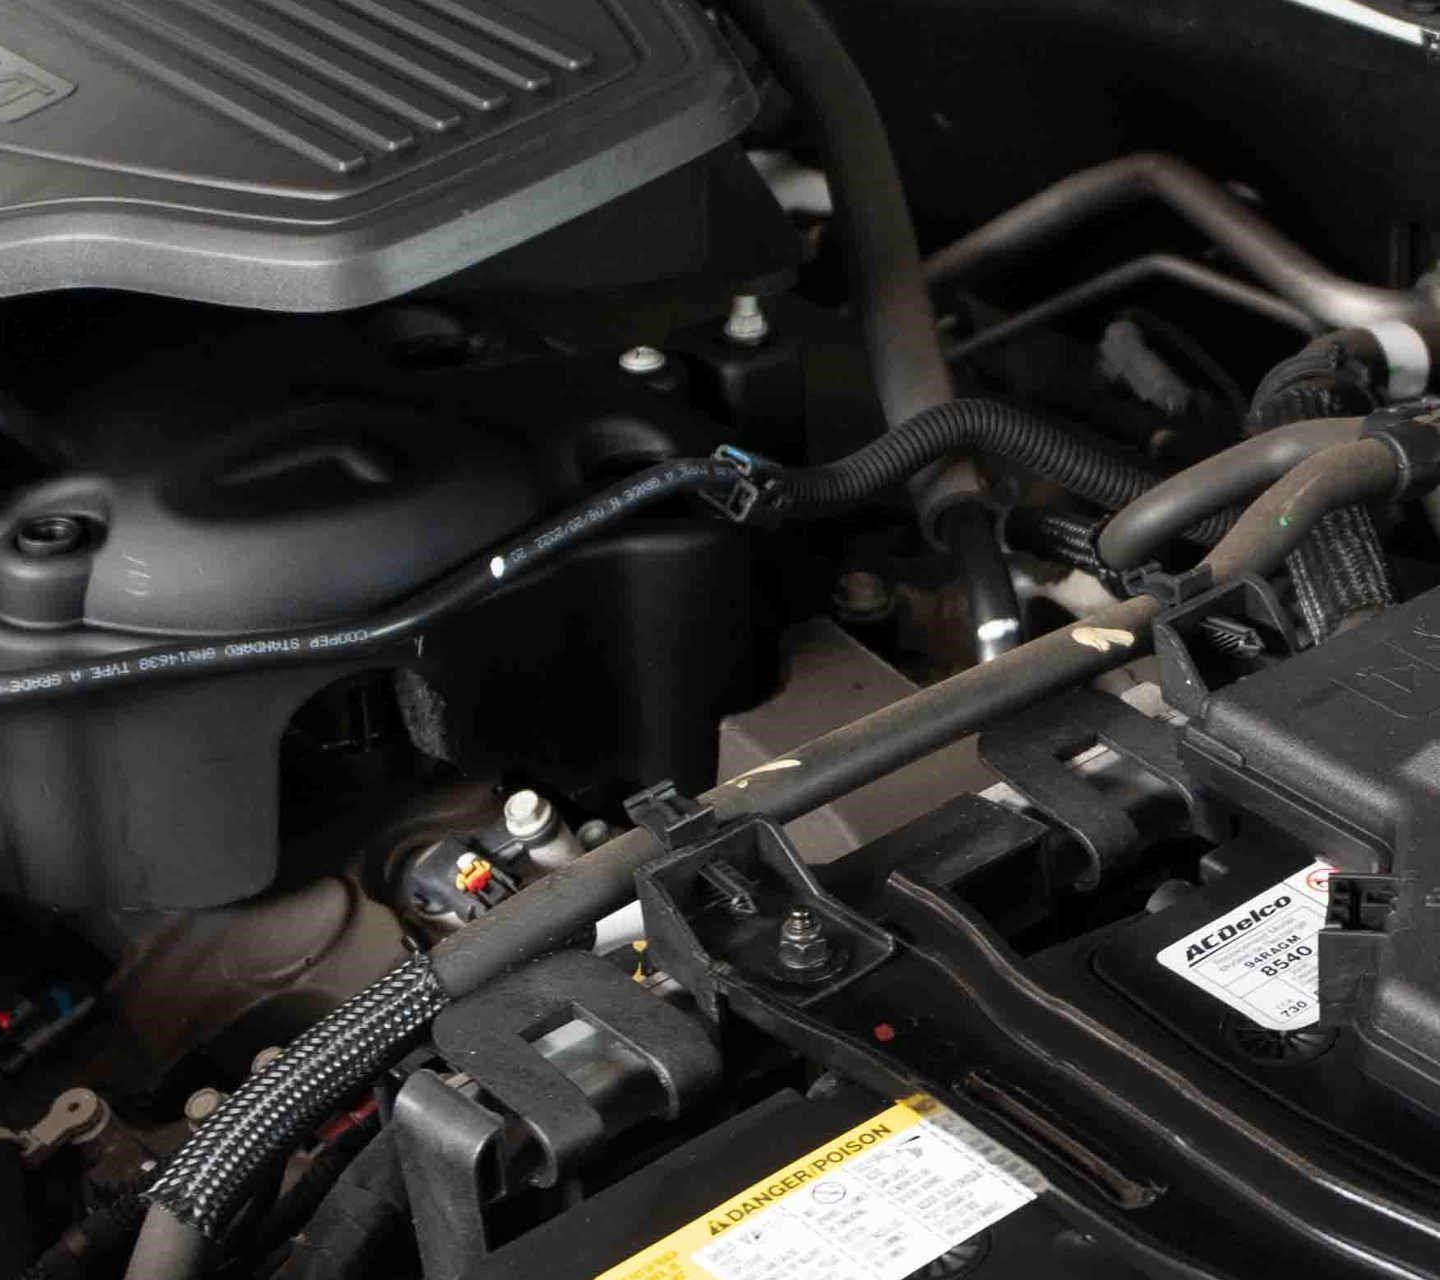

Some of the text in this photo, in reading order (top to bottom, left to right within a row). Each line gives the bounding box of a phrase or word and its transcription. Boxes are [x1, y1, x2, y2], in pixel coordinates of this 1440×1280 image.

[223, 637, 301, 657] STANDARD
[308, 629, 368, 648] COOPER
[139, 647, 216, 670] GMW14638
[69, 669, 81, 681] A
[88, 662, 131, 680] TYPE
[9, 672, 63, 694] GRADE
[1185, 895, 1292, 963] ACDelco
[1244, 934, 1301, 970] 94RAGM
[1260, 944, 1313, 978] 8540
[1281, 999, 1308, 1018] 730
